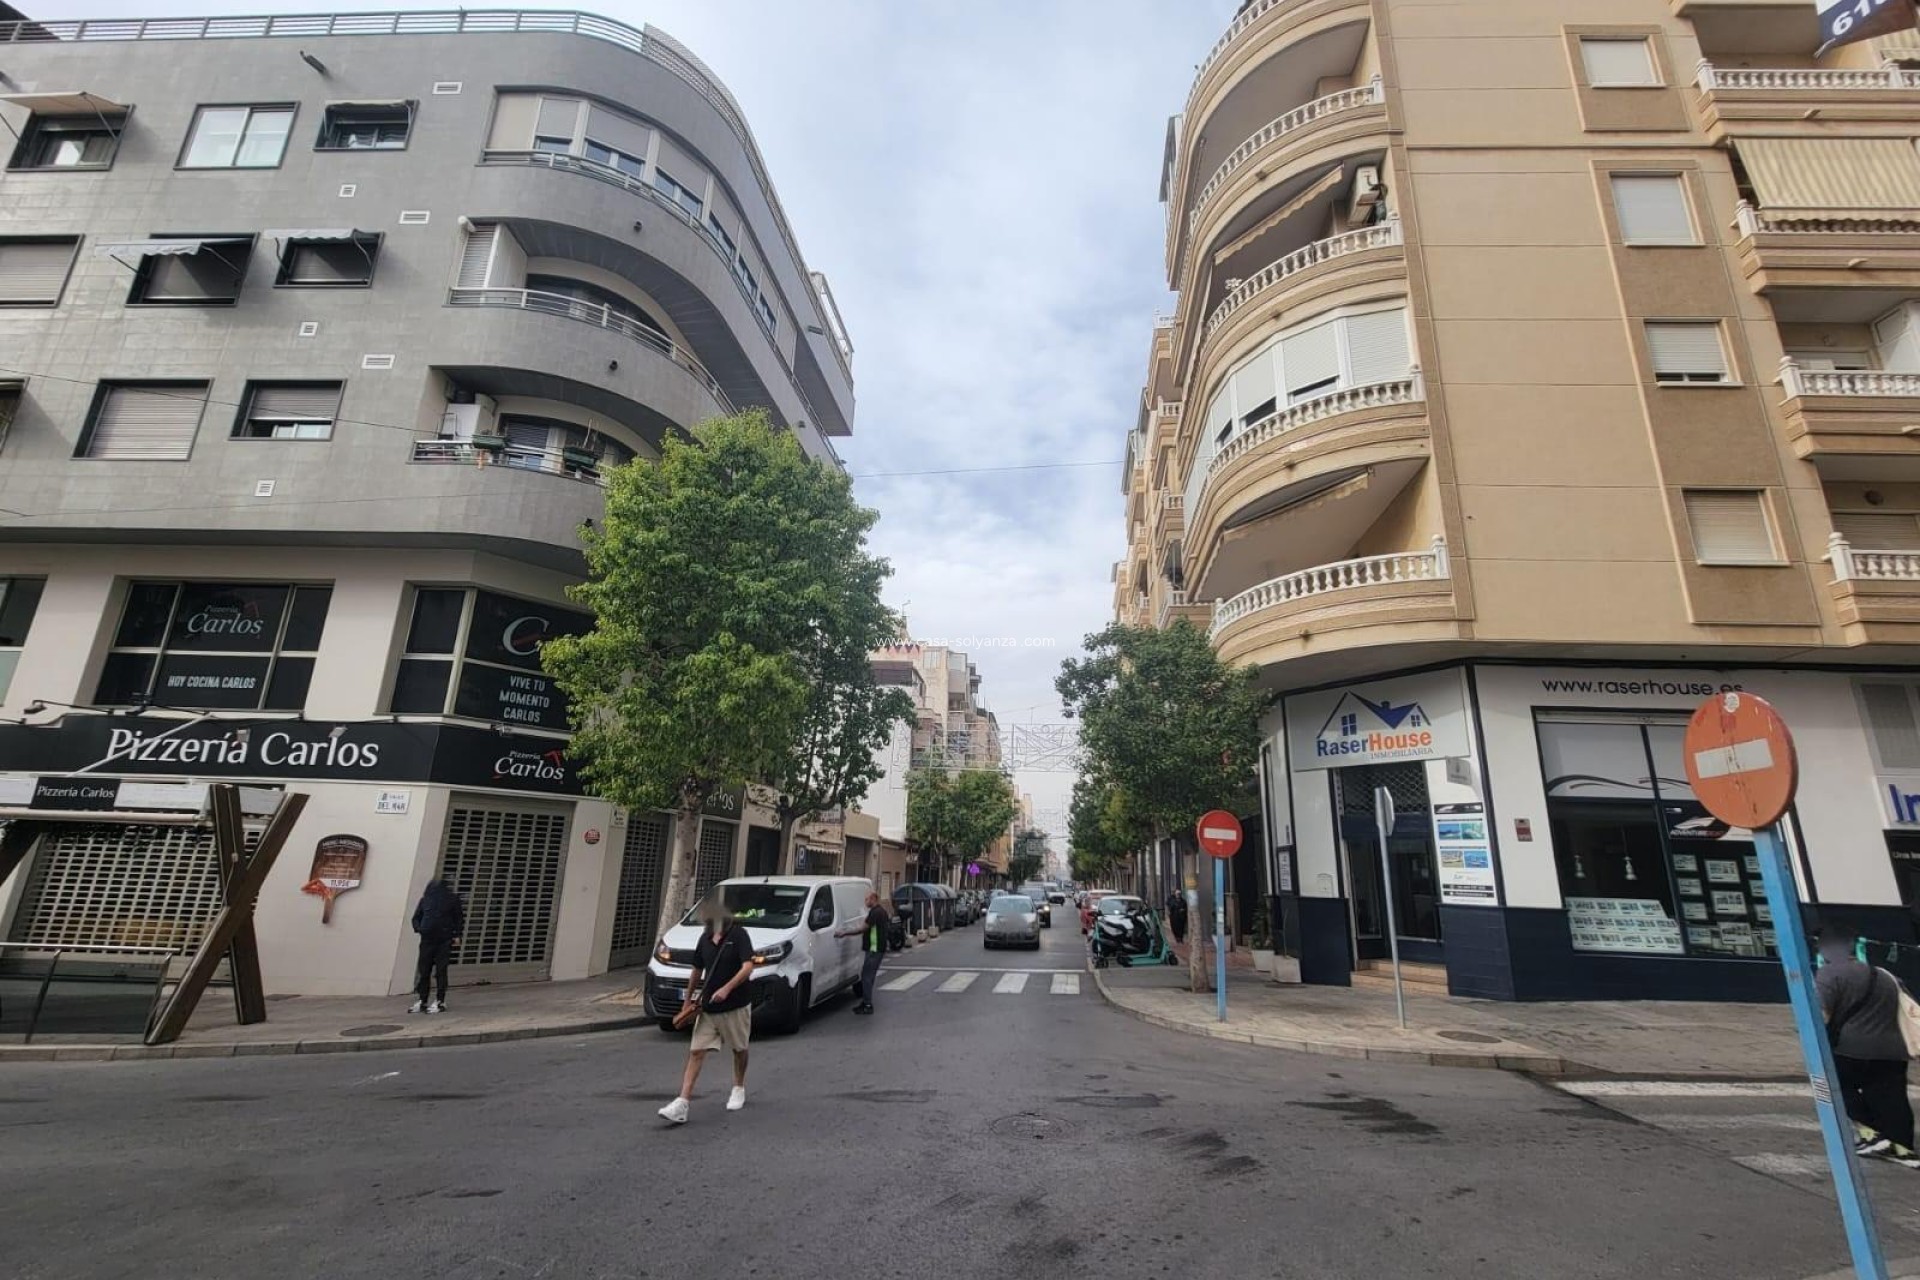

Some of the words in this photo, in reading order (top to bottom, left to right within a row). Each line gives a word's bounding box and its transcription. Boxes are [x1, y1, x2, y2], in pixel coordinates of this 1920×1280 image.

[1832, 0, 1887, 36] 61
[187, 612, 264, 635] Carlos
[502, 616, 550, 656] C
[167, 675, 187, 687] HOY
[187, 676, 219, 688] COCINA
[221, 676, 257, 689] CARLOS
[510, 675, 531, 690] VIVE
[533, 679, 546, 692] TU
[1541, 679, 1744, 696] www.raserhouse.es
[499, 689, 550, 708] MOMENTO
[503, 706, 541, 723] CARLOS
[106, 728, 249, 764] Pizzería
[260, 730, 379, 768] Carlos
[1316, 730, 1432, 757] RaserHouse
[1370, 746, 1434, 760] INMOBILIARIA
[495, 756, 565, 780] Carlos
[80, 786, 115, 798] Carlos
[706, 786, 734, 810] arlos
